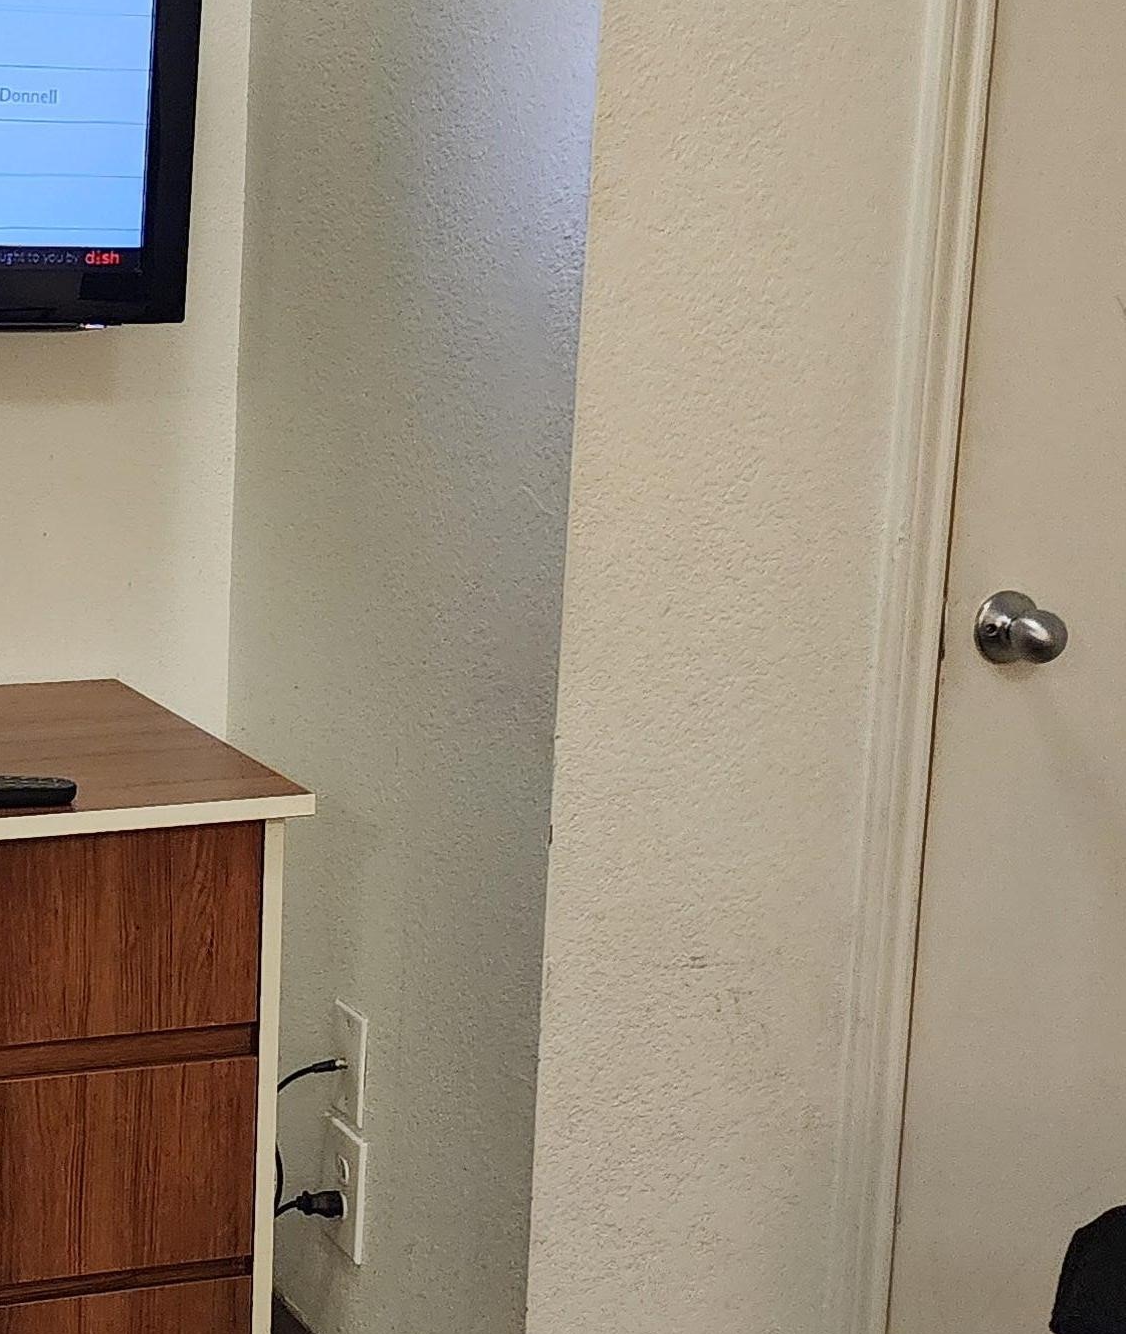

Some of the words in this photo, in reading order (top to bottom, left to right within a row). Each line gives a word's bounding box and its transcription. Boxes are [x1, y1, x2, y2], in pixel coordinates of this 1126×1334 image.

[25, 252, 40, 263] to
[43, 254, 65, 265] you
[85, 250, 120, 265] dish
